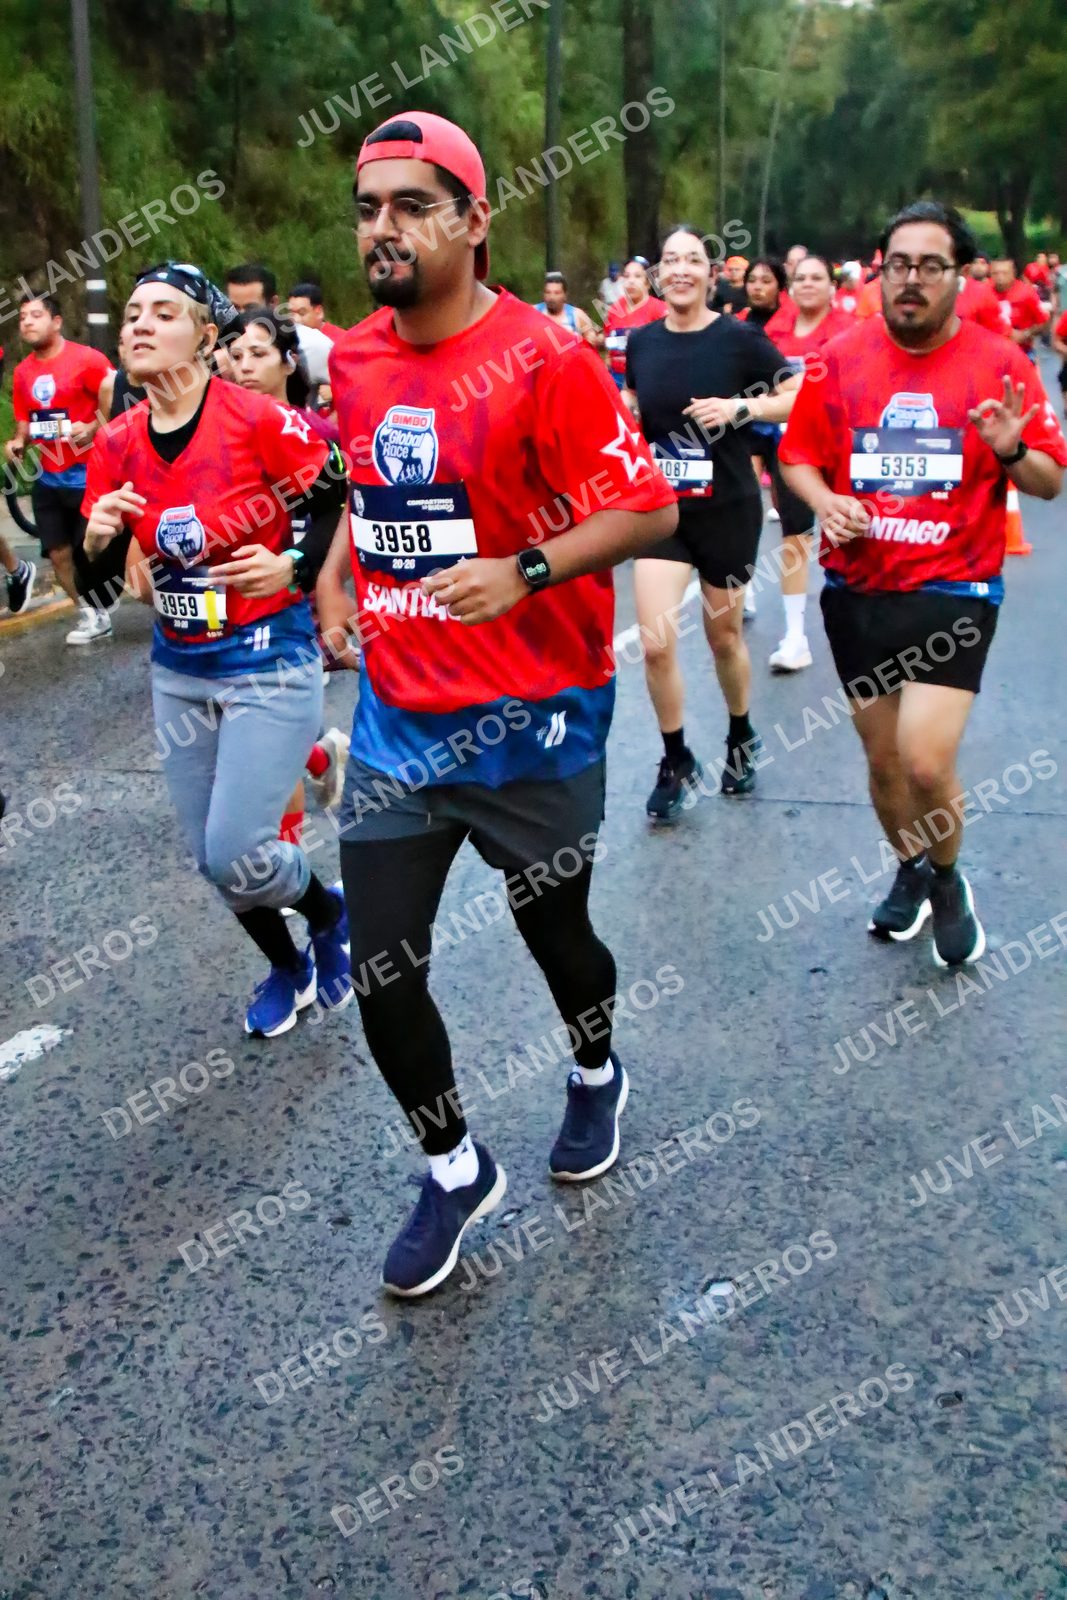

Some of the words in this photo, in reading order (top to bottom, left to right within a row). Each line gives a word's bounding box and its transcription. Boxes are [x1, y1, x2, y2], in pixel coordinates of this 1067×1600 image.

[391, 414, 428, 427] BIMBO
[382, 441, 409, 458] Race
[388, 429, 425, 448] Global
[881, 456, 927, 477] 5353
[372, 523, 432, 553] 3958
[864, 515, 951, 546] NTIAGO
[160, 593, 199, 617] 3959
[363, 581, 461, 622] SANTIA
